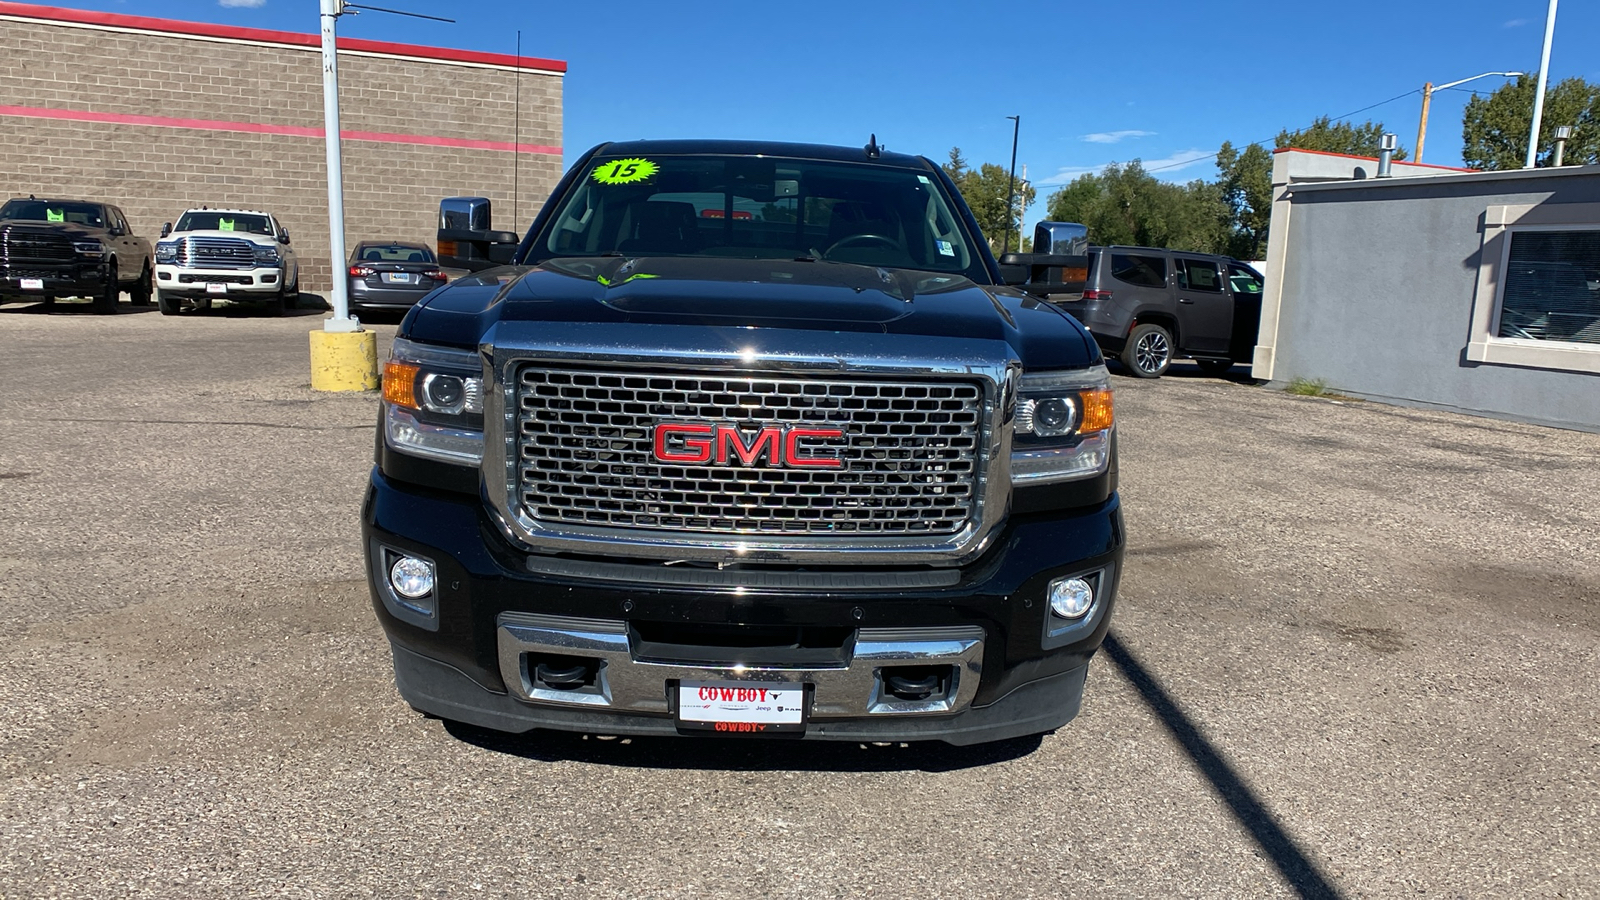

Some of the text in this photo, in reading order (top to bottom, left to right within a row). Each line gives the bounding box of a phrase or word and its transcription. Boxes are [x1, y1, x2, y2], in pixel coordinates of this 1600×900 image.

[610, 163, 640, 178] 15
[653, 422, 846, 469] GMC
[698, 686, 768, 702] COWBOY
[715, 722, 759, 732] COWBOY
